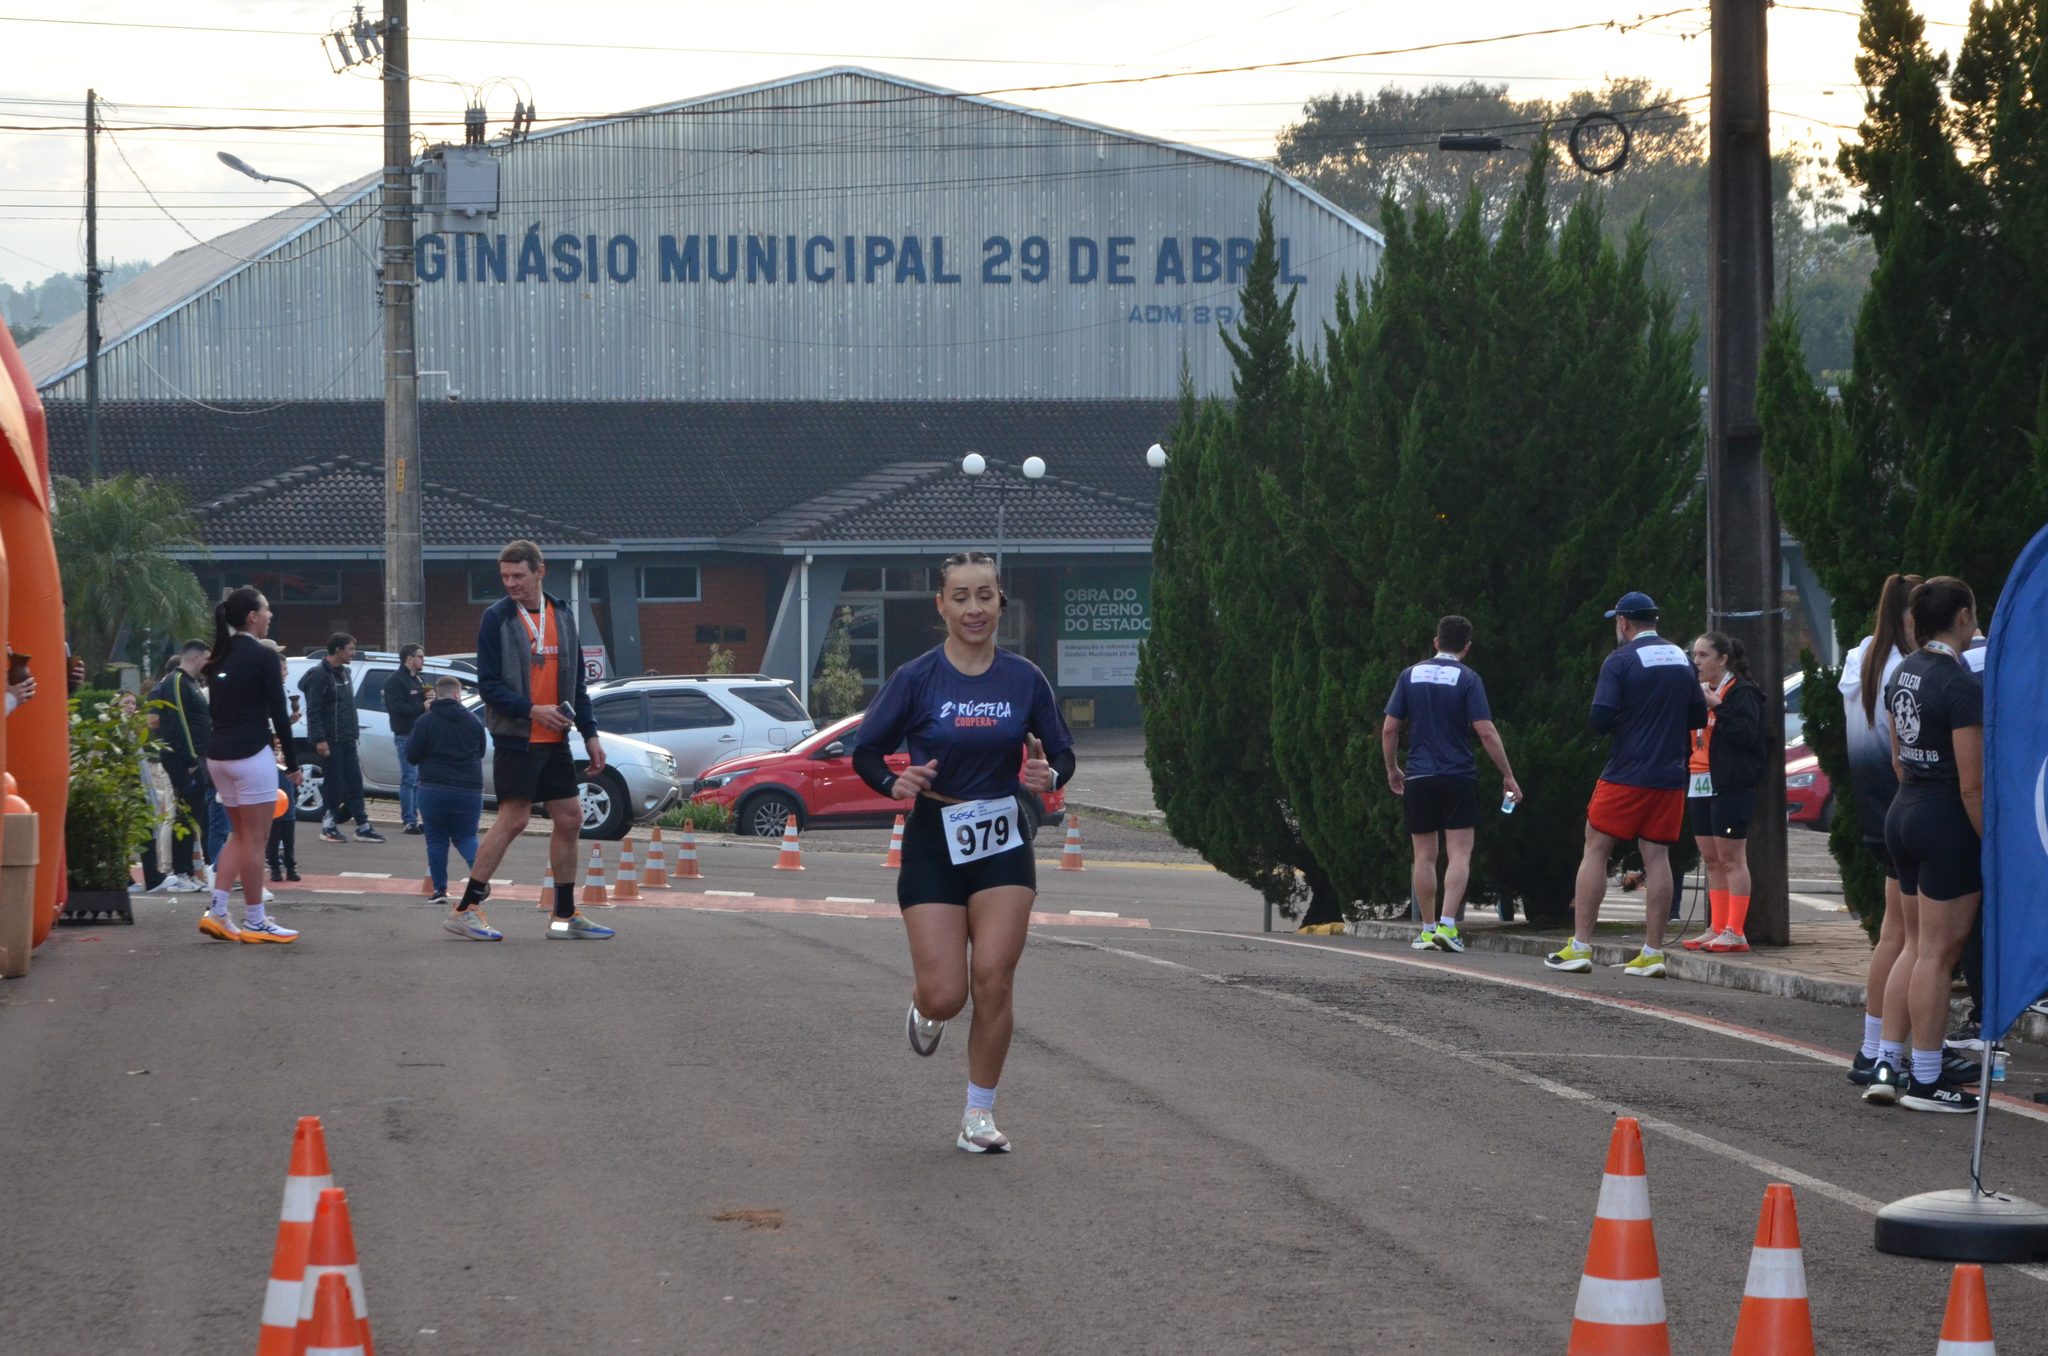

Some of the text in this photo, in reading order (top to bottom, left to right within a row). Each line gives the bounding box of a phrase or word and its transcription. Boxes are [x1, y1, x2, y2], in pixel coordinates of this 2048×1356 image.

[415, 220, 1308, 285] GINÁSIO MUNICIPAL 29 DE ABRL
[1128, 303, 1183, 324] ADM
[1064, 588, 1138, 601] OBRA DO
[1064, 603, 1143, 616] GOVERNO
[1064, 618, 1152, 631] DO ESTADO
[1897, 671, 1921, 691] ATLETA
[1926, 749, 1940, 763] RB
[956, 815, 1009, 856] 979
[1933, 1089, 1962, 1102] FILA
